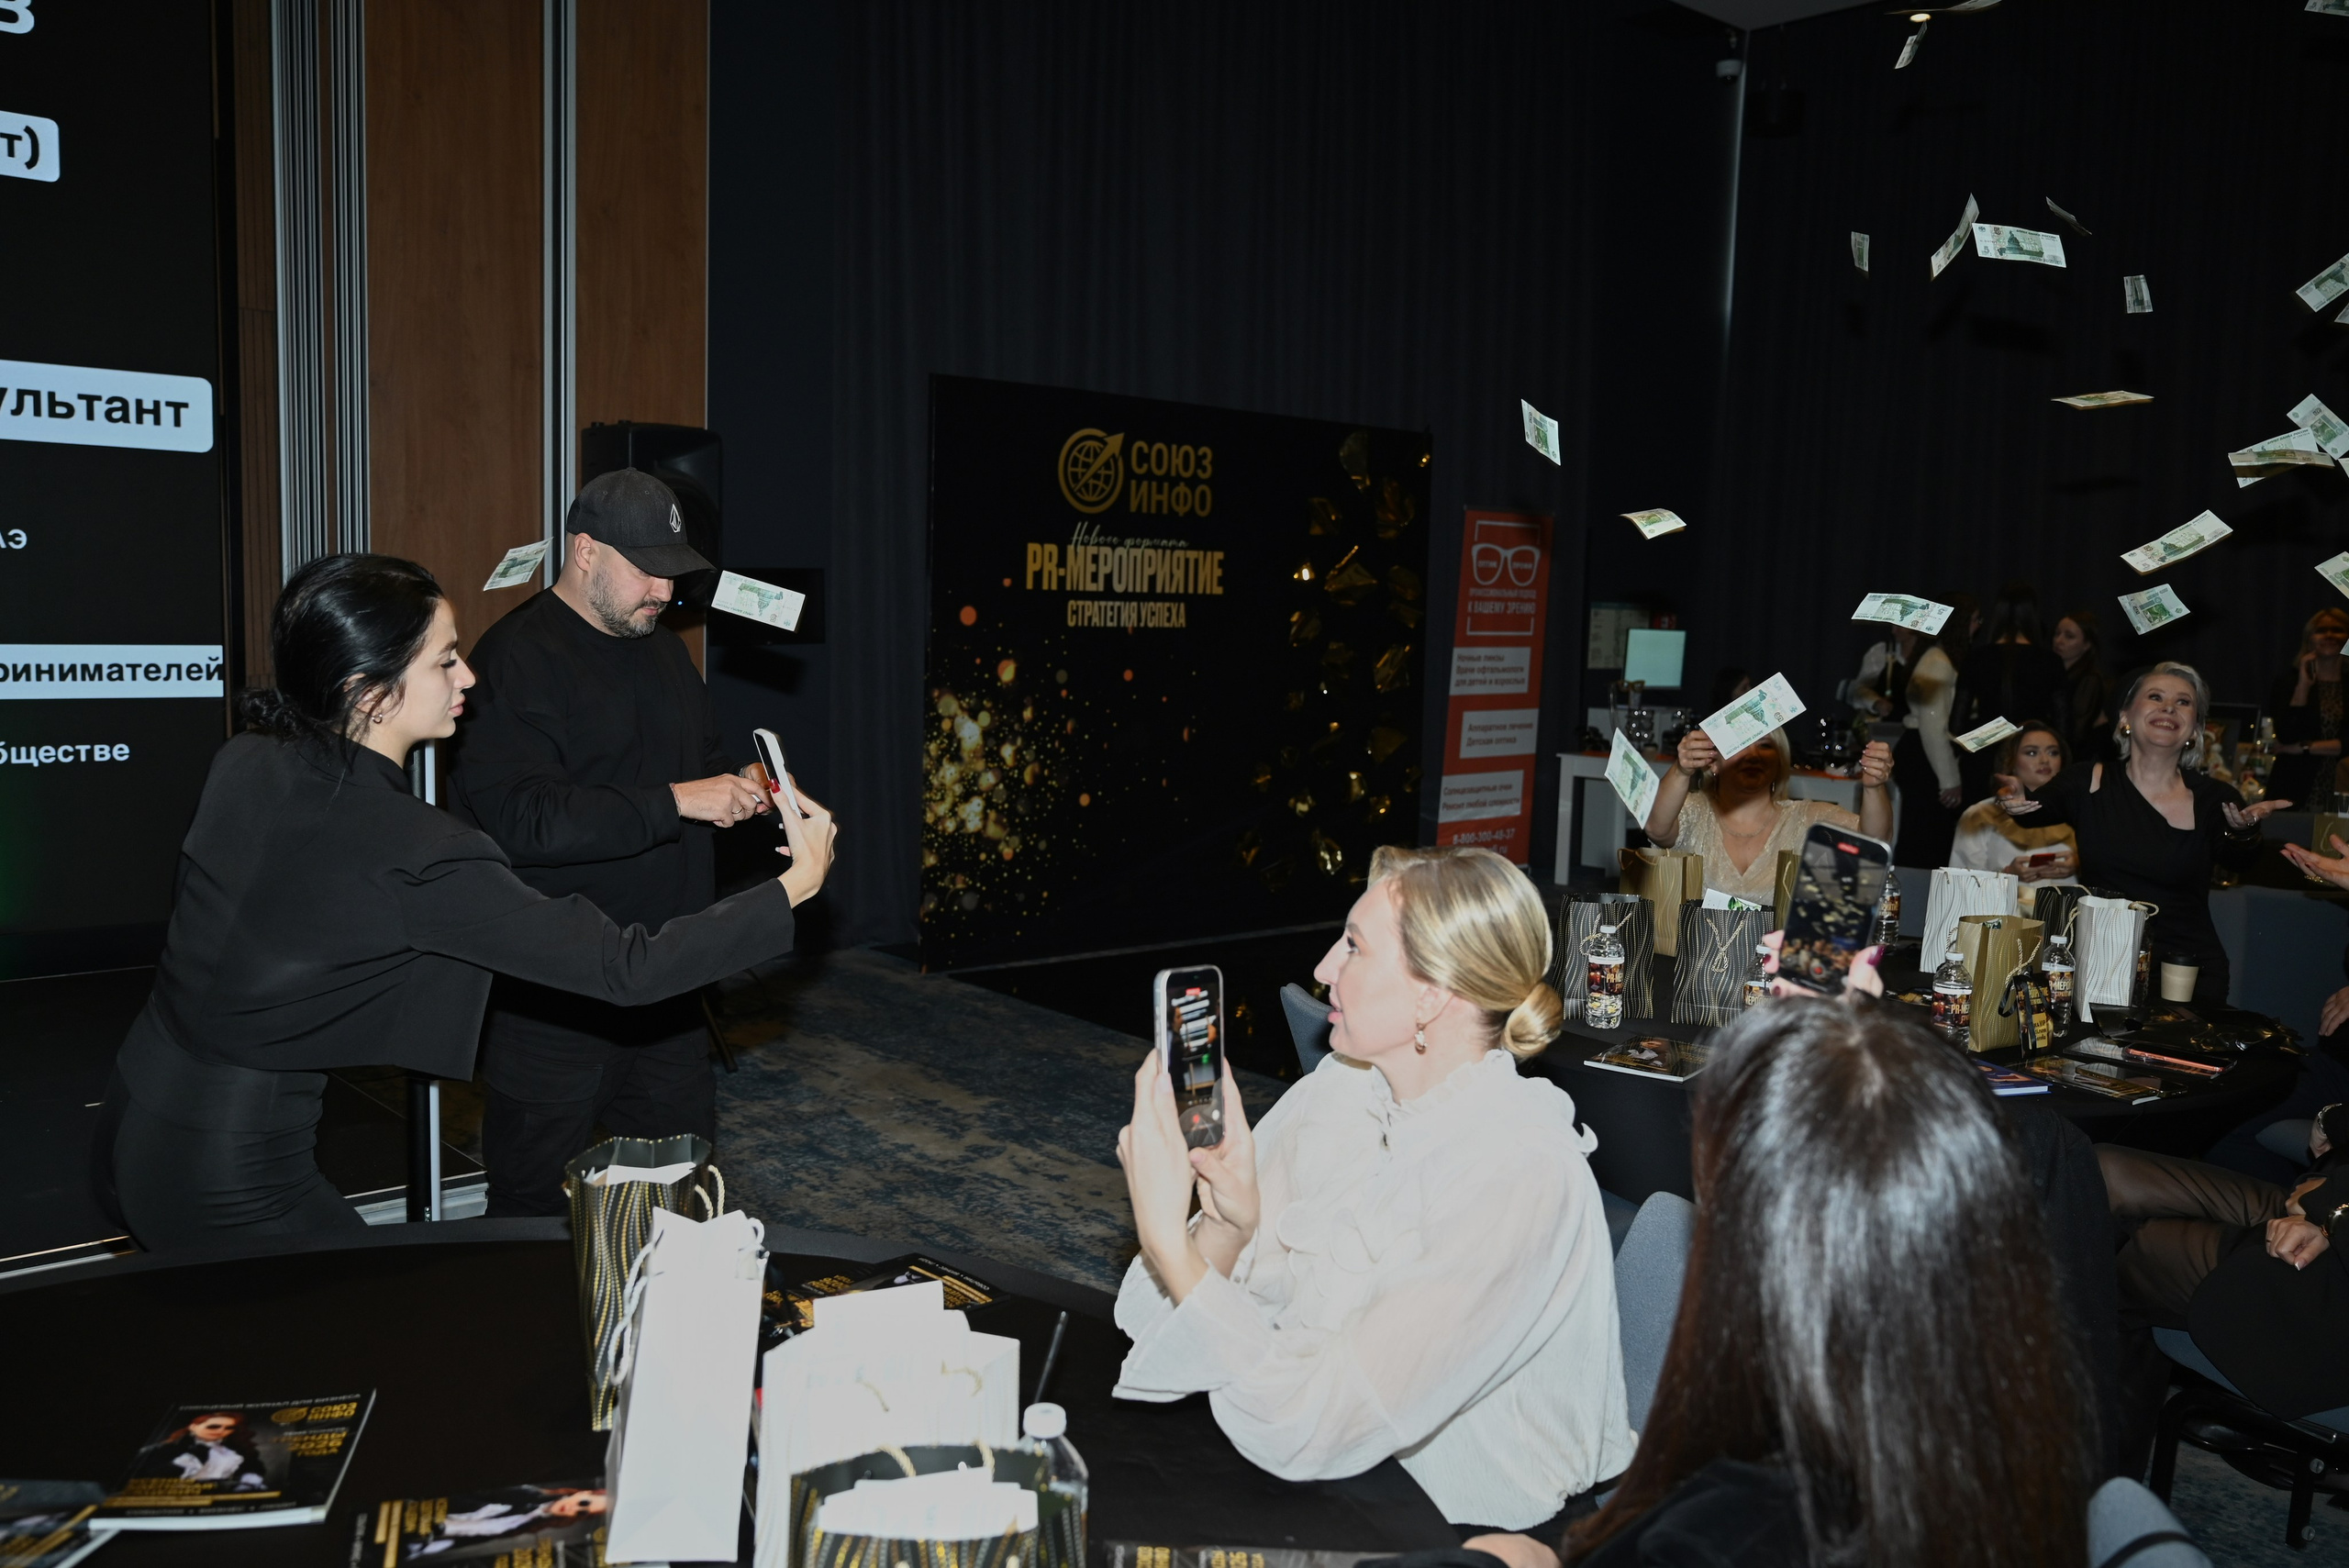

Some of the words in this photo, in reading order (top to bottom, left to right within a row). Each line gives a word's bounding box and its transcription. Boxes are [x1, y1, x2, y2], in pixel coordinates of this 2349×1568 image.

[1130, 440, 1213, 480] СОЮЗ
[1130, 479, 1211, 517] ИНФО
[1026, 542, 1225, 595] PR-МЕРОПРИЯТИЕ
[1067, 600, 1138, 628] СТРАТЕГИЯ
[1140, 602, 1186, 628] УСПЕХА
[309, 1402, 359, 1414] СОЮЗ
